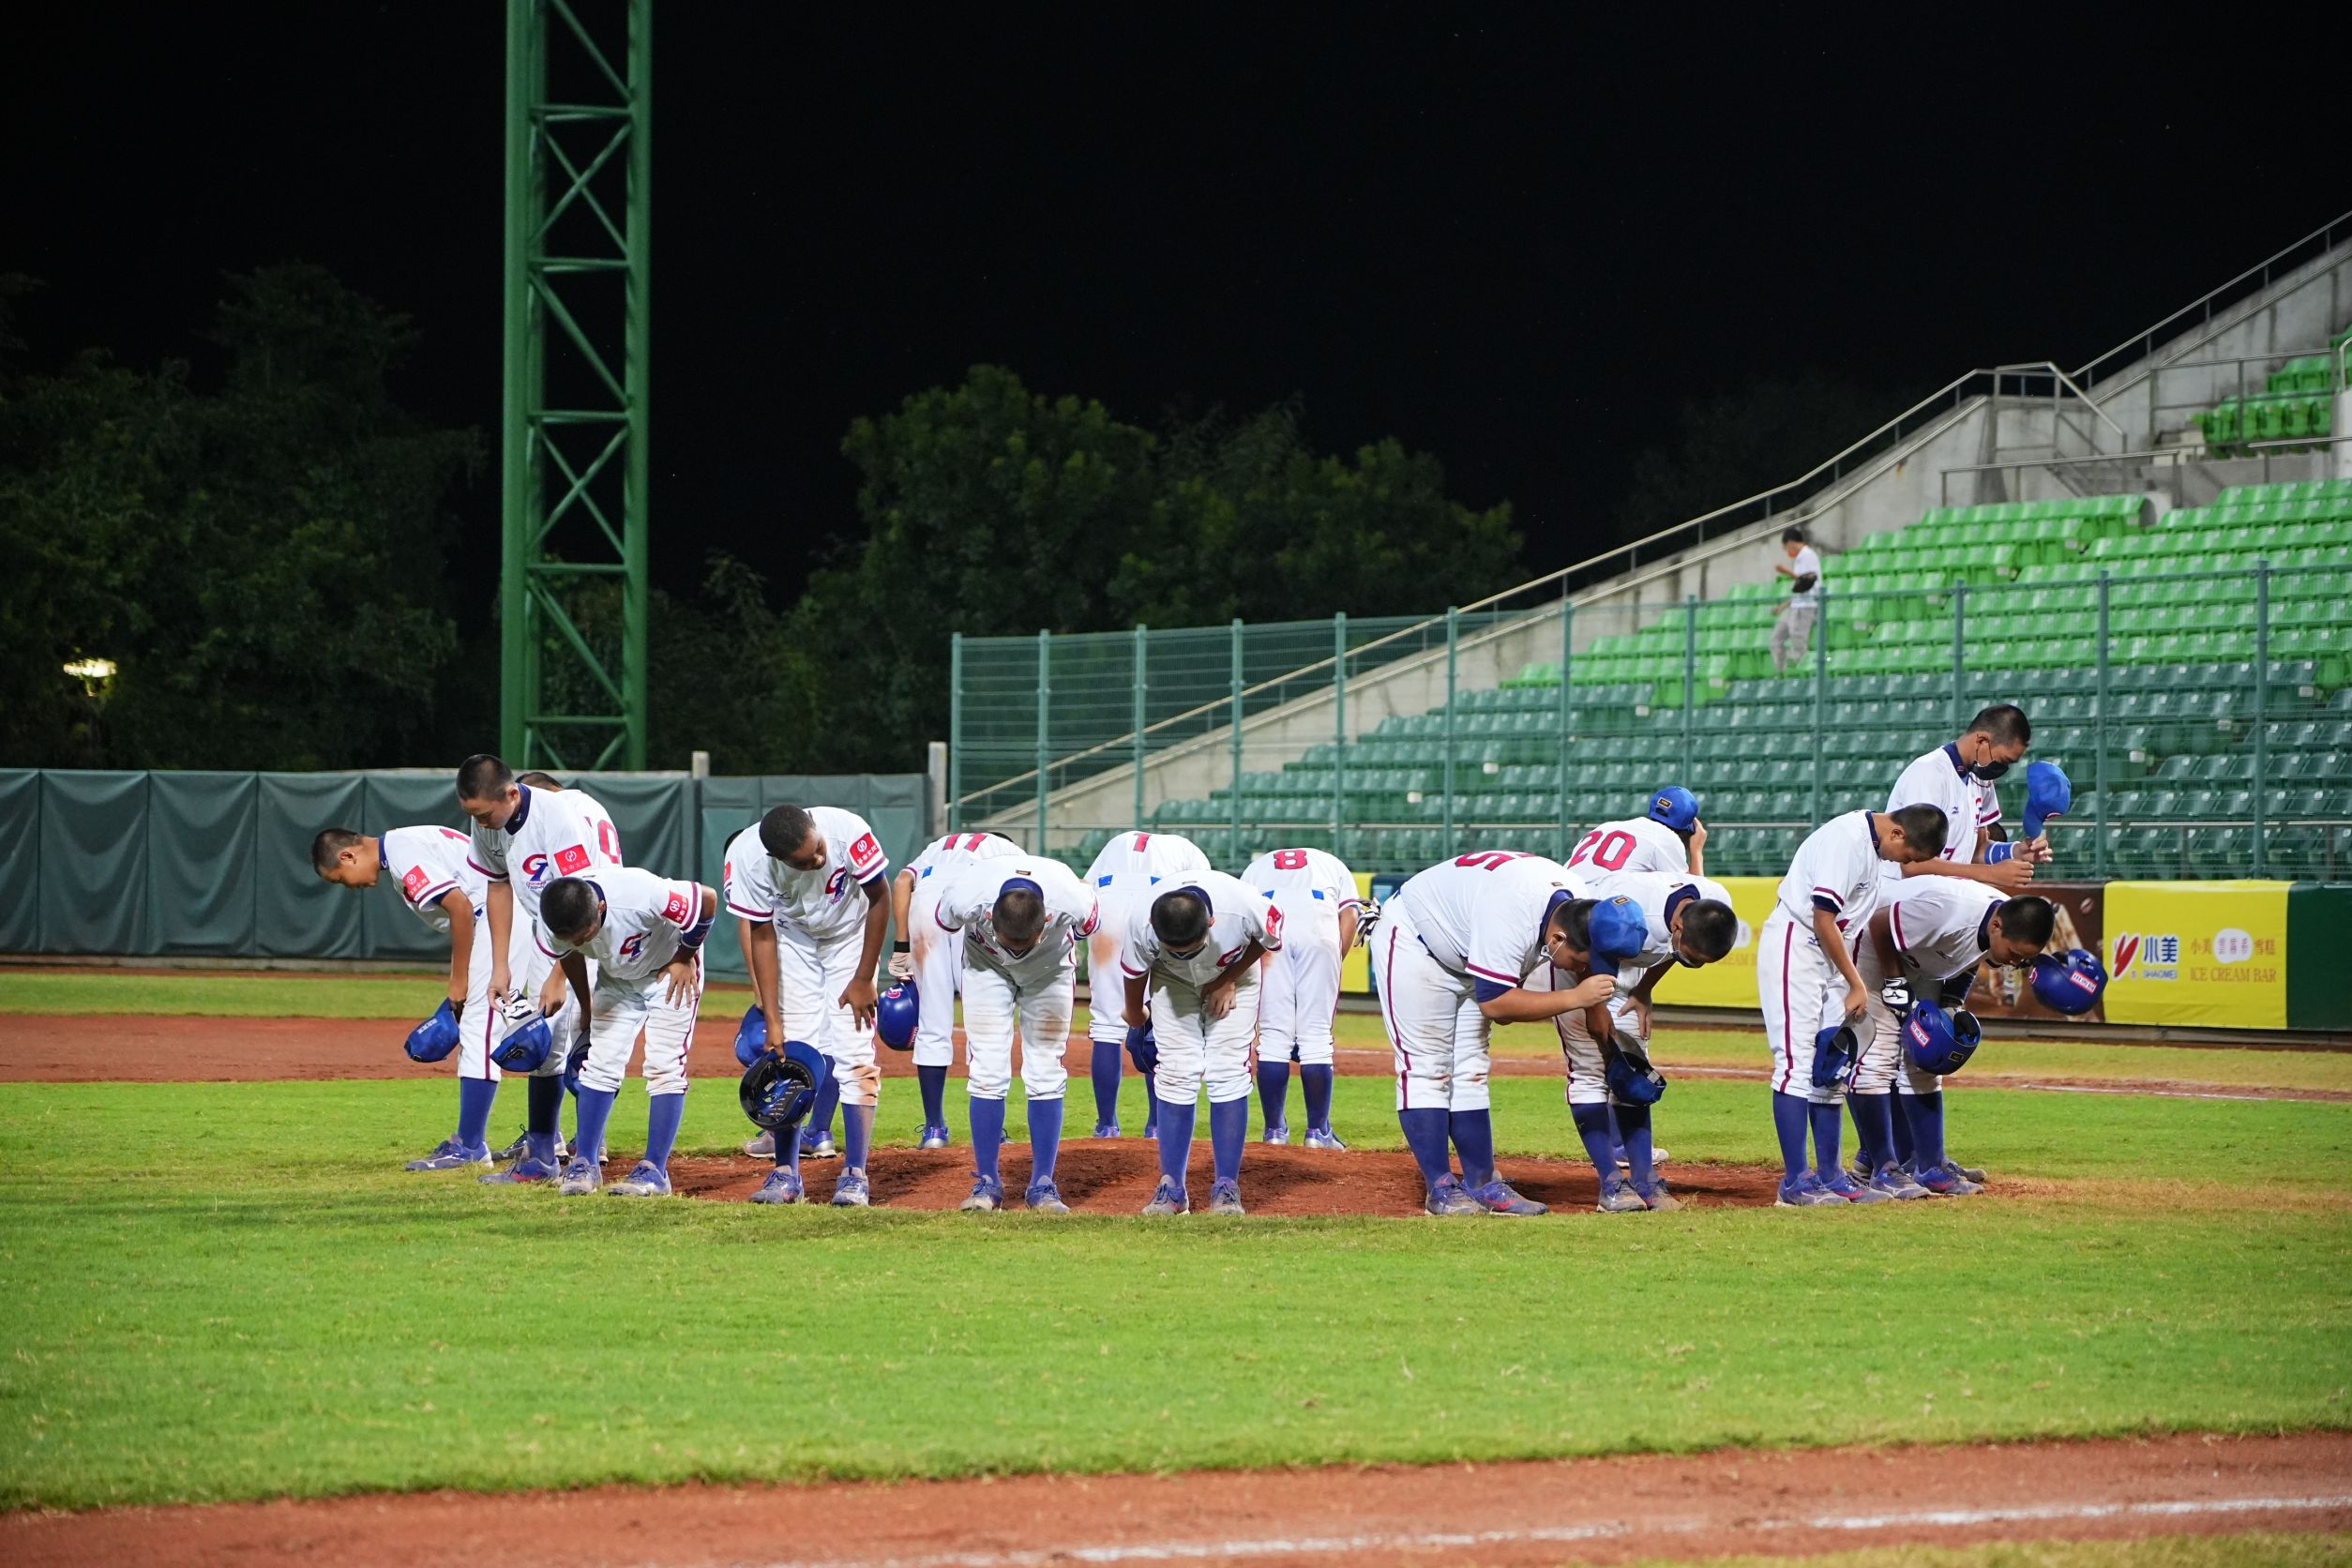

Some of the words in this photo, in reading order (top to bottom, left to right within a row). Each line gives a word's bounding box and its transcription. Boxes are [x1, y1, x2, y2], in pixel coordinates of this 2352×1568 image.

[1274, 849, 1307, 870] 8
[1567, 830, 1636, 871] 20
[2143, 936, 2179, 963] 小美
[2190, 967, 2208, 983] ICE
[2210, 967, 2250, 983] CREAM
[2254, 968, 2277, 983] BAR
